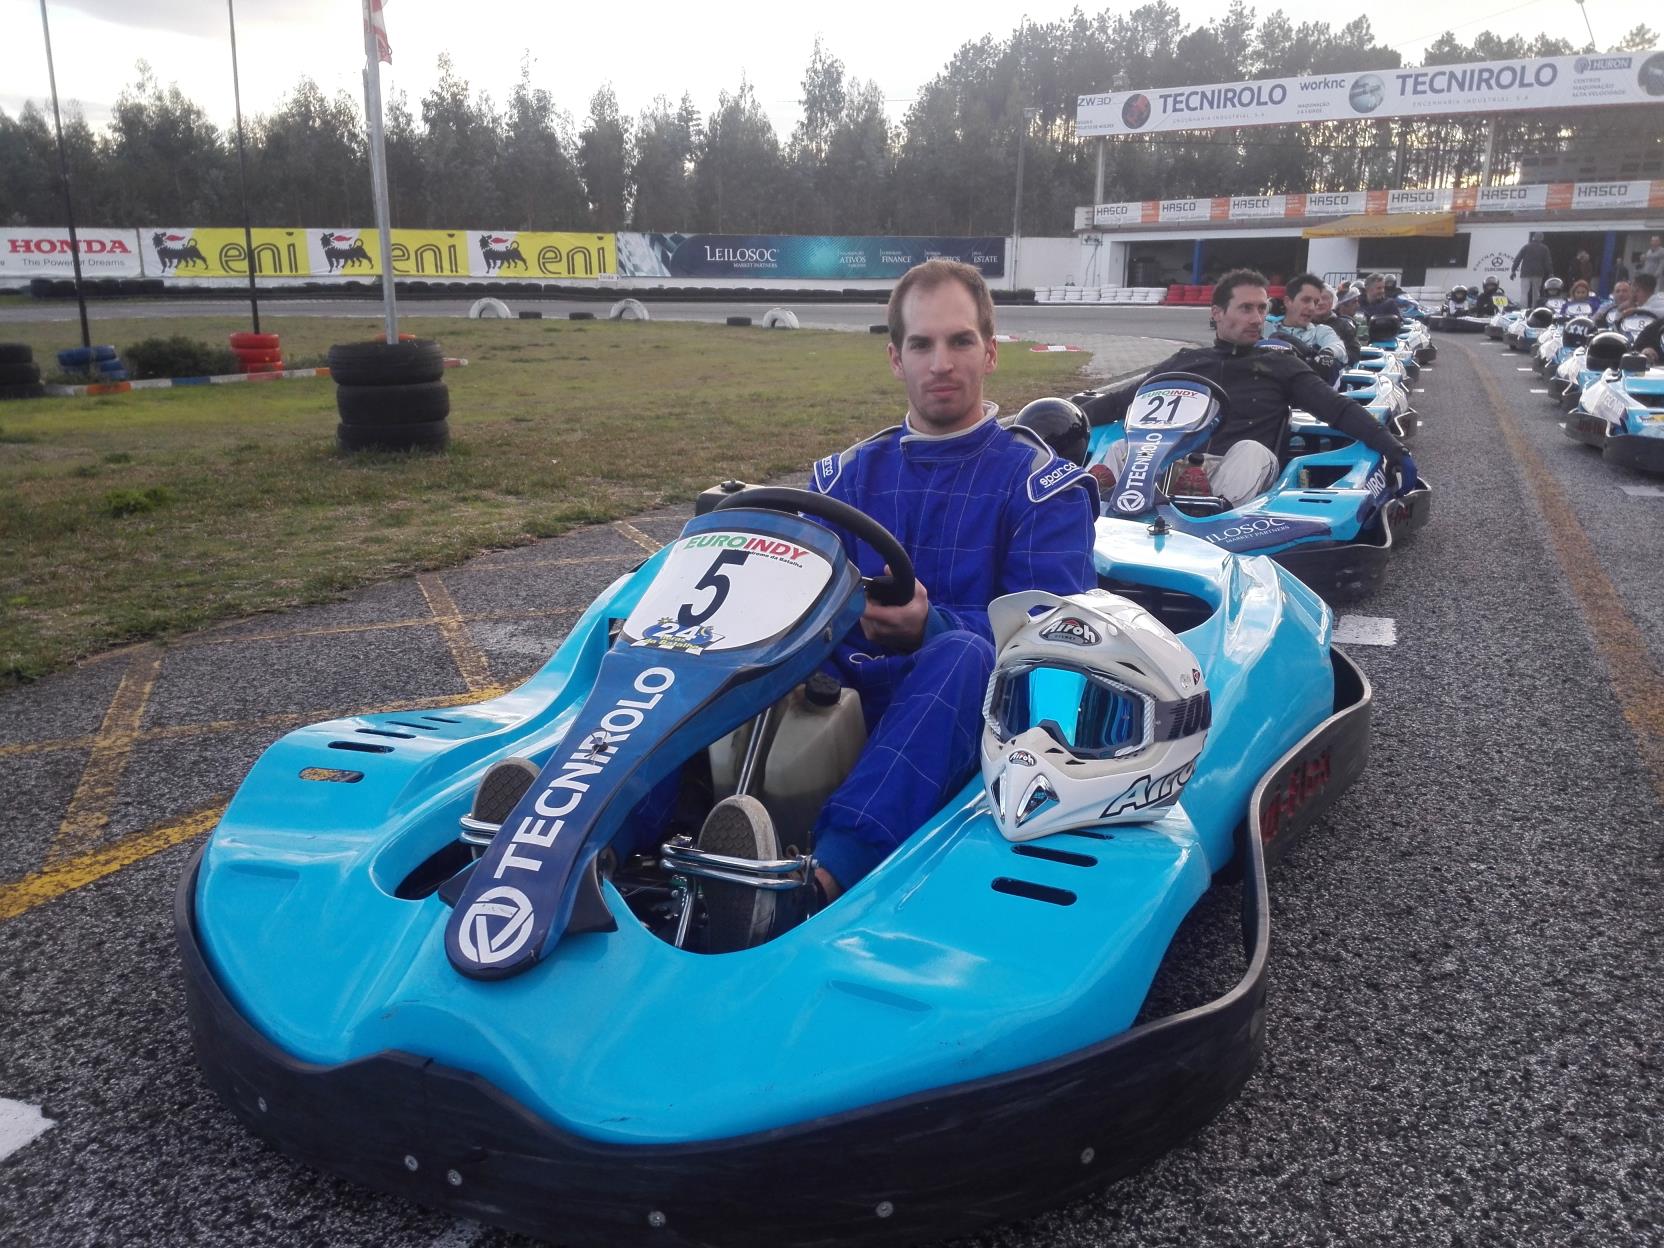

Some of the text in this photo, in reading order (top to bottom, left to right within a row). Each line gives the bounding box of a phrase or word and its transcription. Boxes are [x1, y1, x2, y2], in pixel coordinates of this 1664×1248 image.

[1592, 58, 1629, 69] HURON
[1300, 78, 1345, 91] worknc
[1396, 63, 1558, 96] TECNIROLO
[1159, 84, 1287, 114] TECNIROLO
[1391, 192, 1434, 203] HASCO
[1481, 188, 1527, 200] HASCO
[1578, 185, 1628, 197] HASCO
[1162, 203, 1196, 212] HASCO
[1232, 199, 1270, 210] HASCO
[1309, 195, 1349, 206] HASCO
[1096, 206, 1127, 216] HASCO
[8, 239, 131, 254] HONDA
[219, 231, 299, 273] eni
[391, 233, 459, 274] eni
[704, 246, 777, 262] LEILOSOC
[23, 258, 40, 266] The
[88, 258, 126, 266] Dreams
[537, 235, 605, 275] eni
[881, 255, 912, 264] FINANCE
[973, 255, 998, 263] ESTATE
[1140, 395, 1183, 422] 21
[1039, 462, 1077, 487] sparco
[683, 534, 811, 561] EUROINDY
[677, 548, 750, 628] 5
[652, 622, 701, 641] 24
[1041, 619, 1096, 643] Airoh
[1009, 751, 1035, 766] Airoh
[493, 666, 676, 880] TECNIROLO
